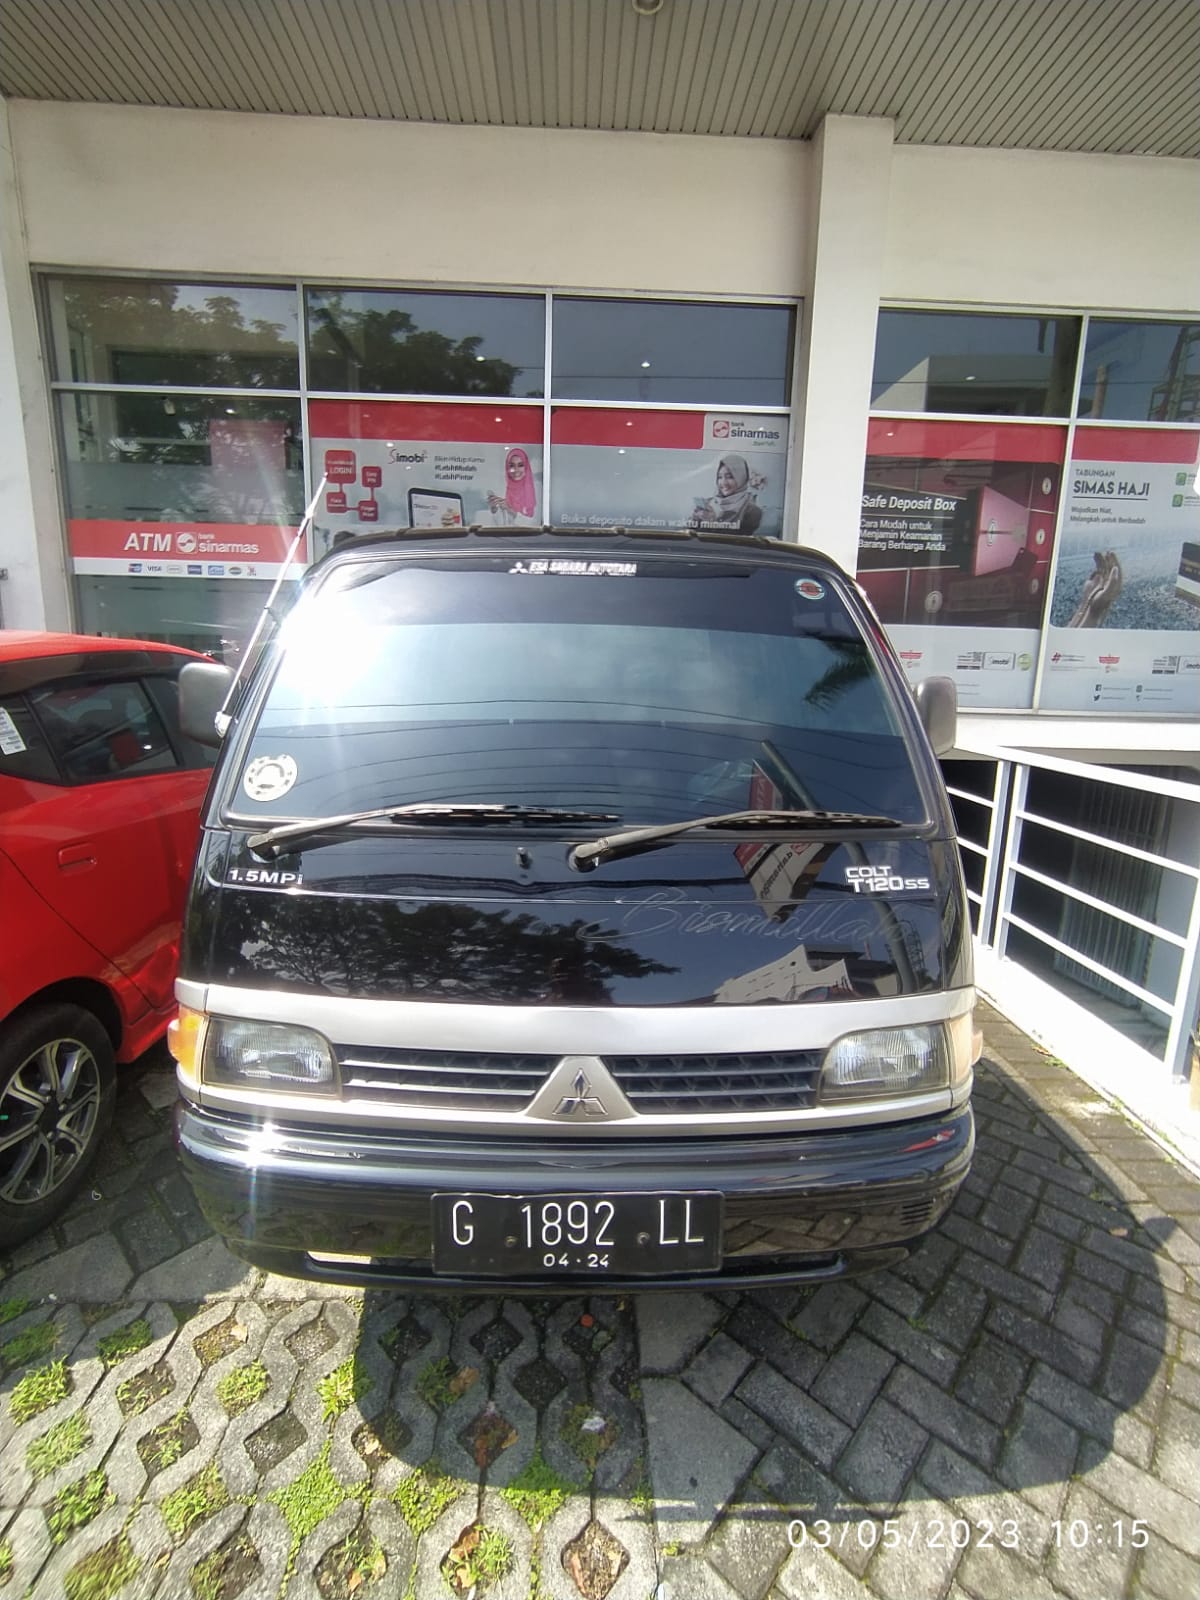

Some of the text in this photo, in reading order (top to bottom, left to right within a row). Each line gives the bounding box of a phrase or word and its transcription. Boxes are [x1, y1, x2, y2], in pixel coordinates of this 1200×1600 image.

[730, 427, 780, 439] sinarmas
[1075, 468, 1116, 477] TABUNGAN
[1073, 480, 1151, 496] SIMAS HAJI
[862, 495, 957, 512] Safe Deposit Box
[560, 513, 587, 524] Buka
[700, 519, 741, 530] minimal
[860, 519, 933, 530] Cara Mudah untuk
[123, 532, 172, 552] ATM
[859, 529, 943, 541] Menjamin Keamanan
[198, 540, 260, 554] sinarmas
[858, 539, 946, 552] Barang Berharga Anda
[229, 869, 304, 885] 1.5MPi
[845, 866, 891, 878] COLT
[452, 1200, 704, 1248] G 1892 LL
